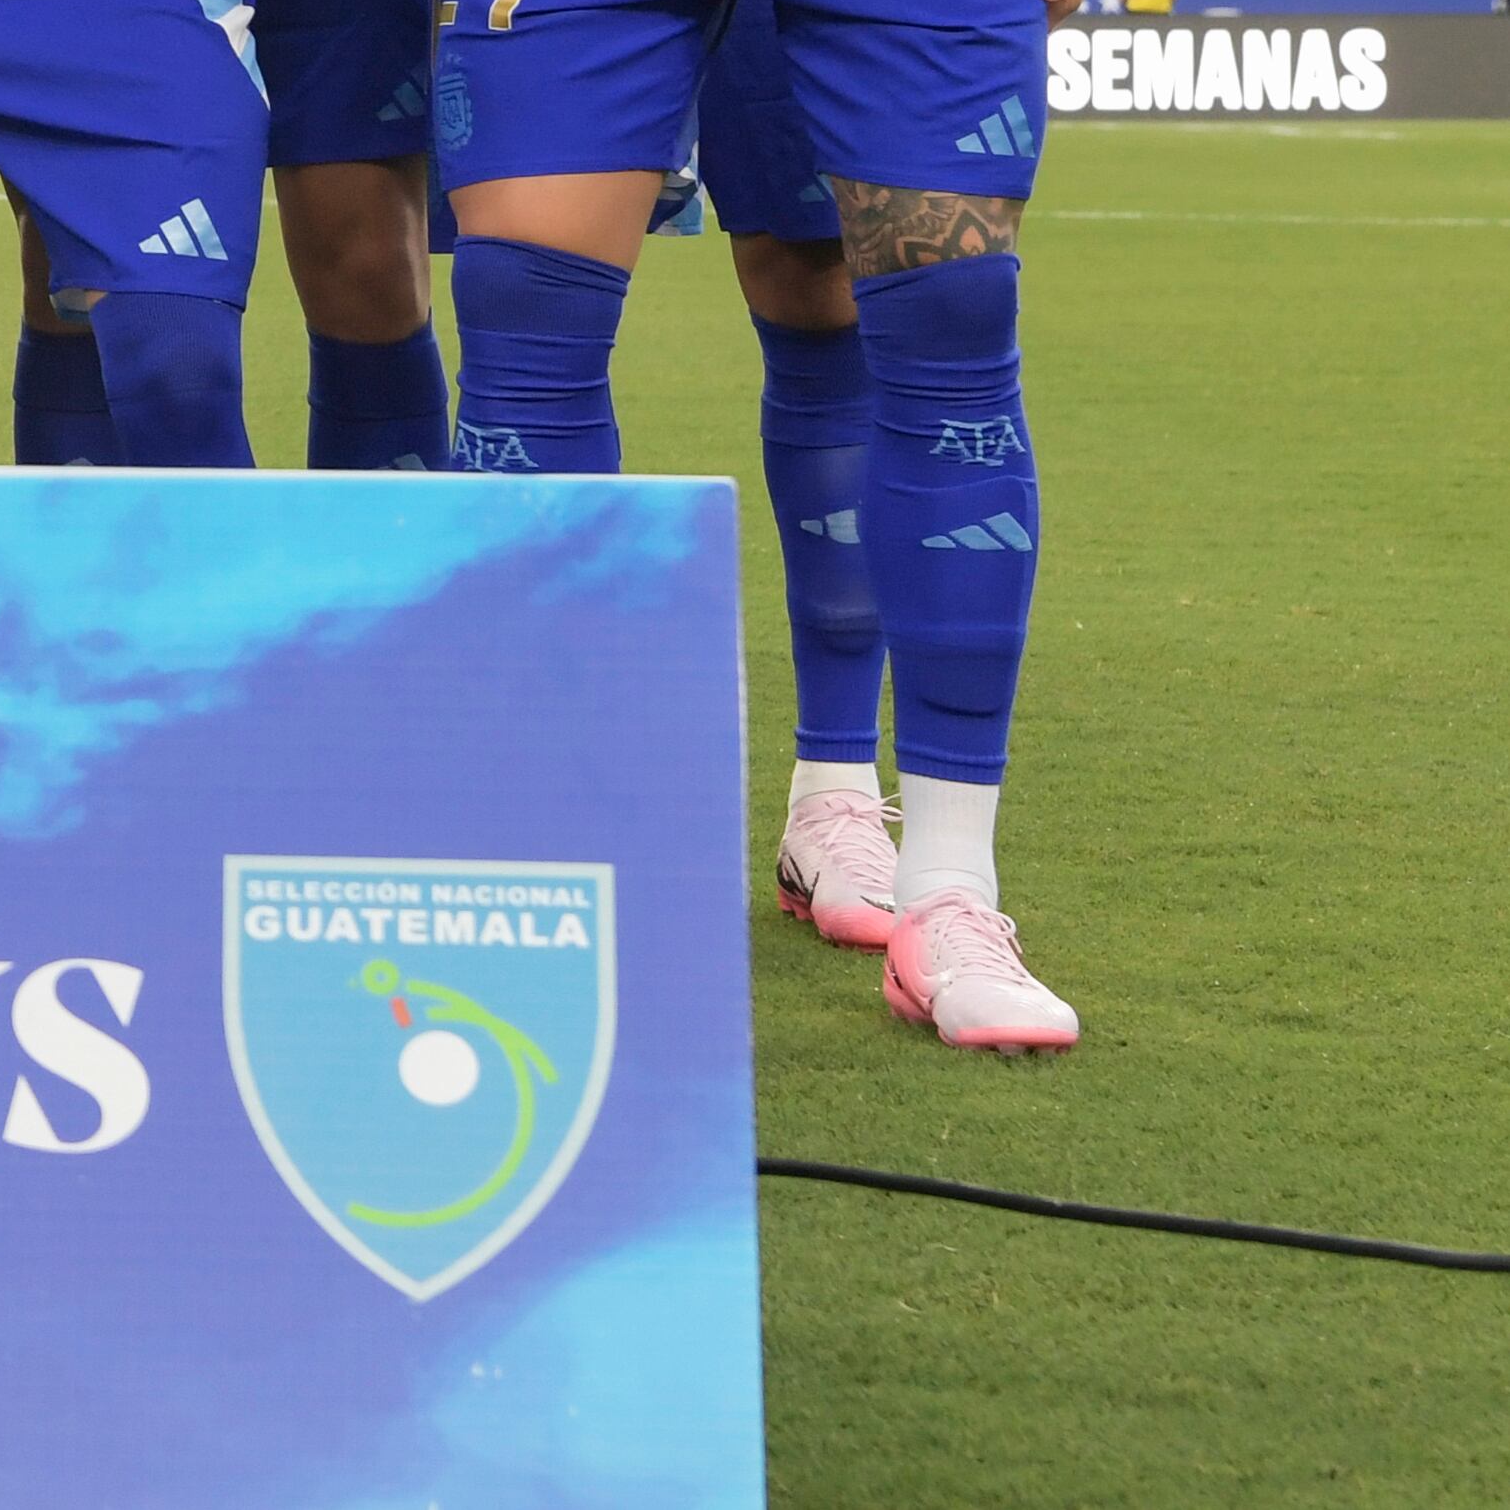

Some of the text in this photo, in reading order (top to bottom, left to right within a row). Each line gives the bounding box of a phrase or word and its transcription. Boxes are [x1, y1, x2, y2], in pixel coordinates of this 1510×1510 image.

[1047, 27, 1388, 112] SEMANAS
[928, 414, 1027, 467] AFA
[245, 877, 592, 910] SELECCIÓN NACIONAL
[243, 903, 591, 950] GUATEMALA
